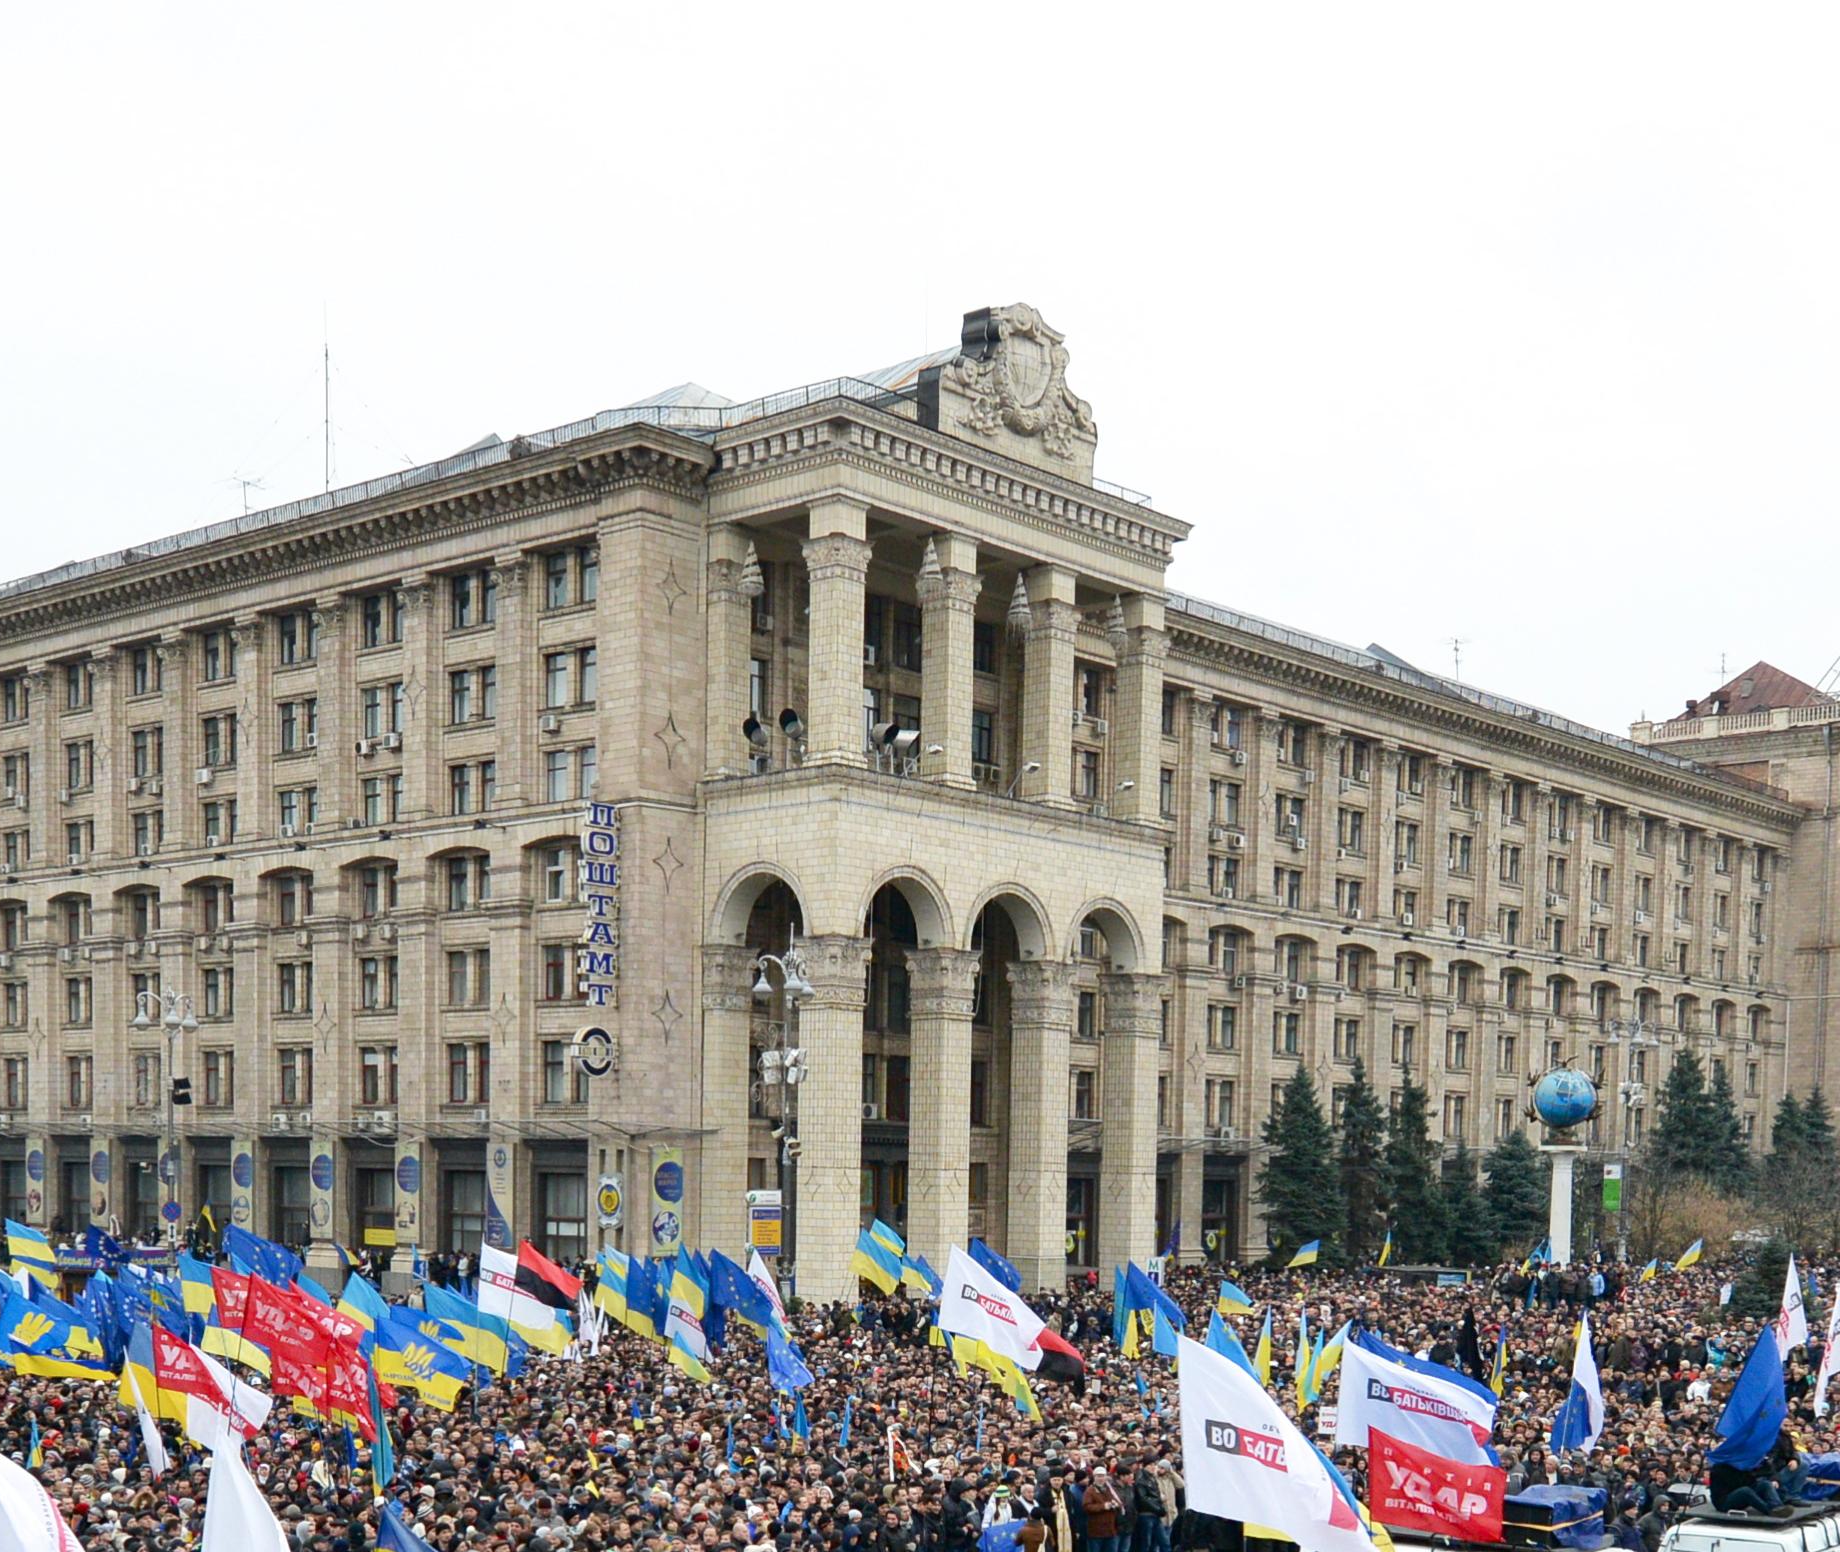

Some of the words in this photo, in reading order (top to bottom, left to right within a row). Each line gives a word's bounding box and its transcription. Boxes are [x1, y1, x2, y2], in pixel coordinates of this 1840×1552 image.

[585, 803, 617, 1006] ПОШТАМТ
[963, 1285, 978, 1300] ВО
[1210, 1425, 1237, 1448] ВО
[1384, 1460, 1488, 1521] УДАР
